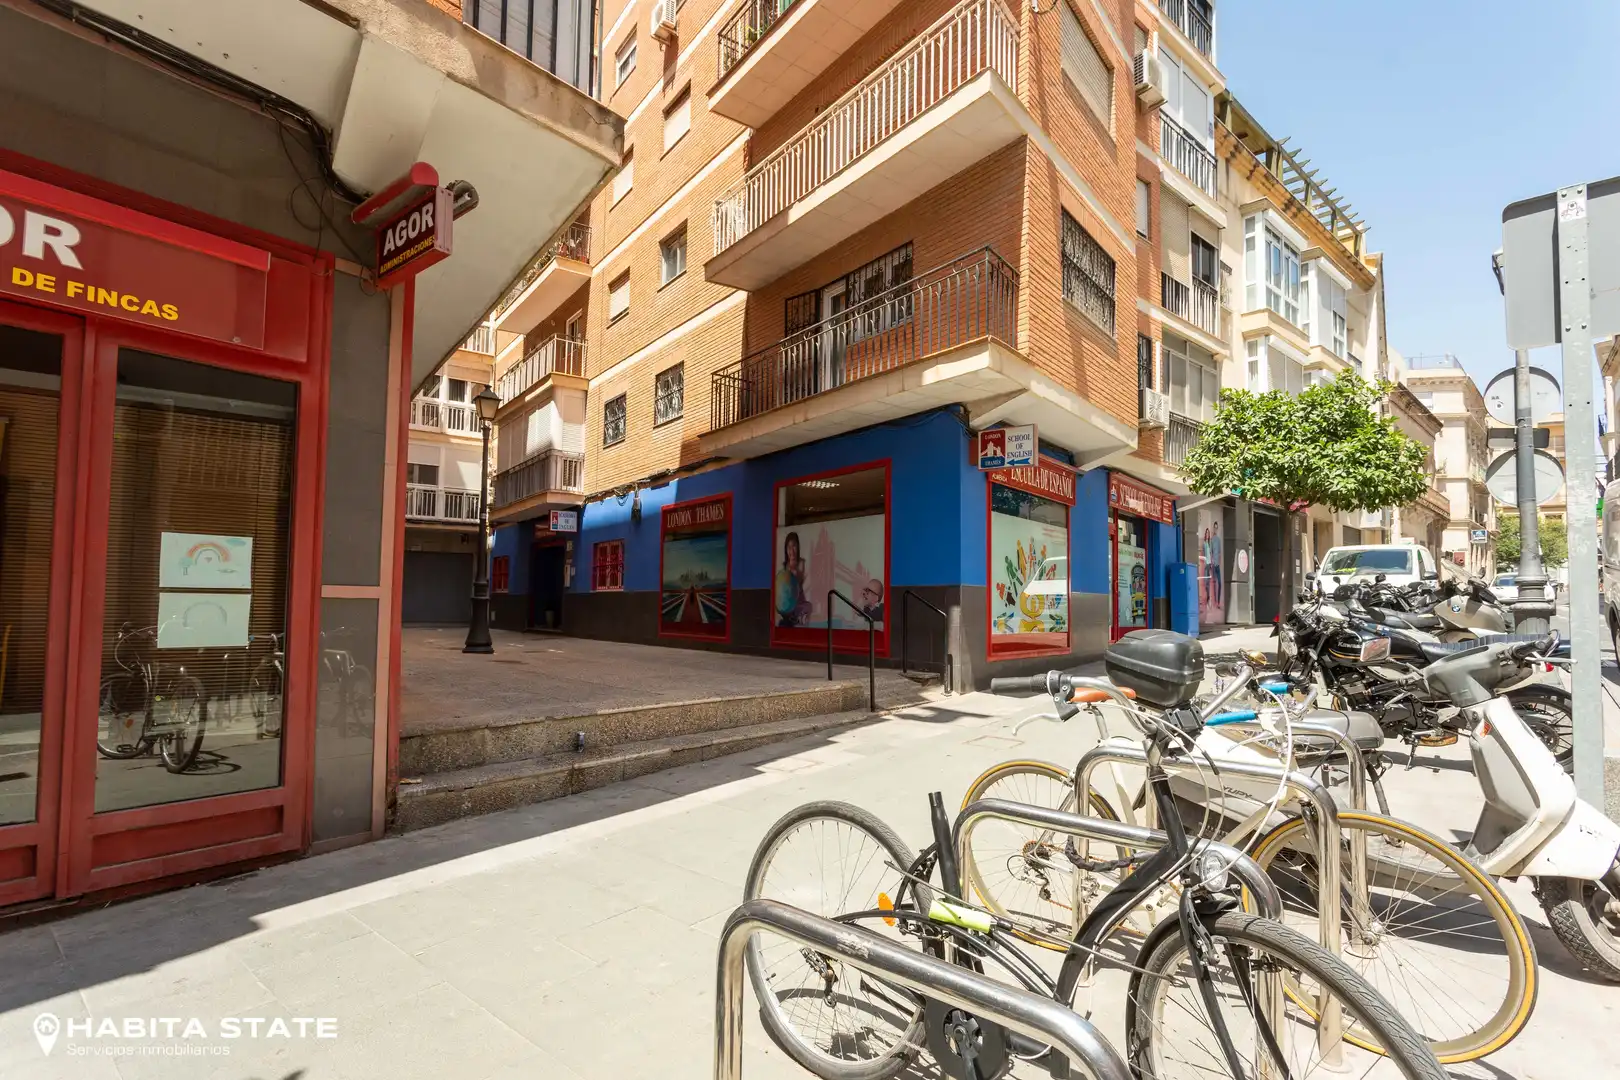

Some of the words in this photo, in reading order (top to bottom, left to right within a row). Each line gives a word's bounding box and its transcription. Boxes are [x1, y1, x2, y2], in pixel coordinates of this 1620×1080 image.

[0, 204, 85, 270] R
[383, 202, 434, 256] AGOR
[380, 234, 436, 273] ADMINISTRACIONES
[12, 266, 56, 292] DE
[67, 280, 179, 321] FINCAS
[1007, 433, 1032, 443] SCHOOL
[1007, 449, 1033, 459] ENGLISH
[1015, 442, 1024, 450] OF
[1011, 467, 1040, 488] ESCUELA
[1040, 469, 1049, 491] DE
[1049, 471, 1073, 499] ESPAÑOL
[667, 509, 692, 528] LONDON
[697, 503, 724, 524] THAMES
